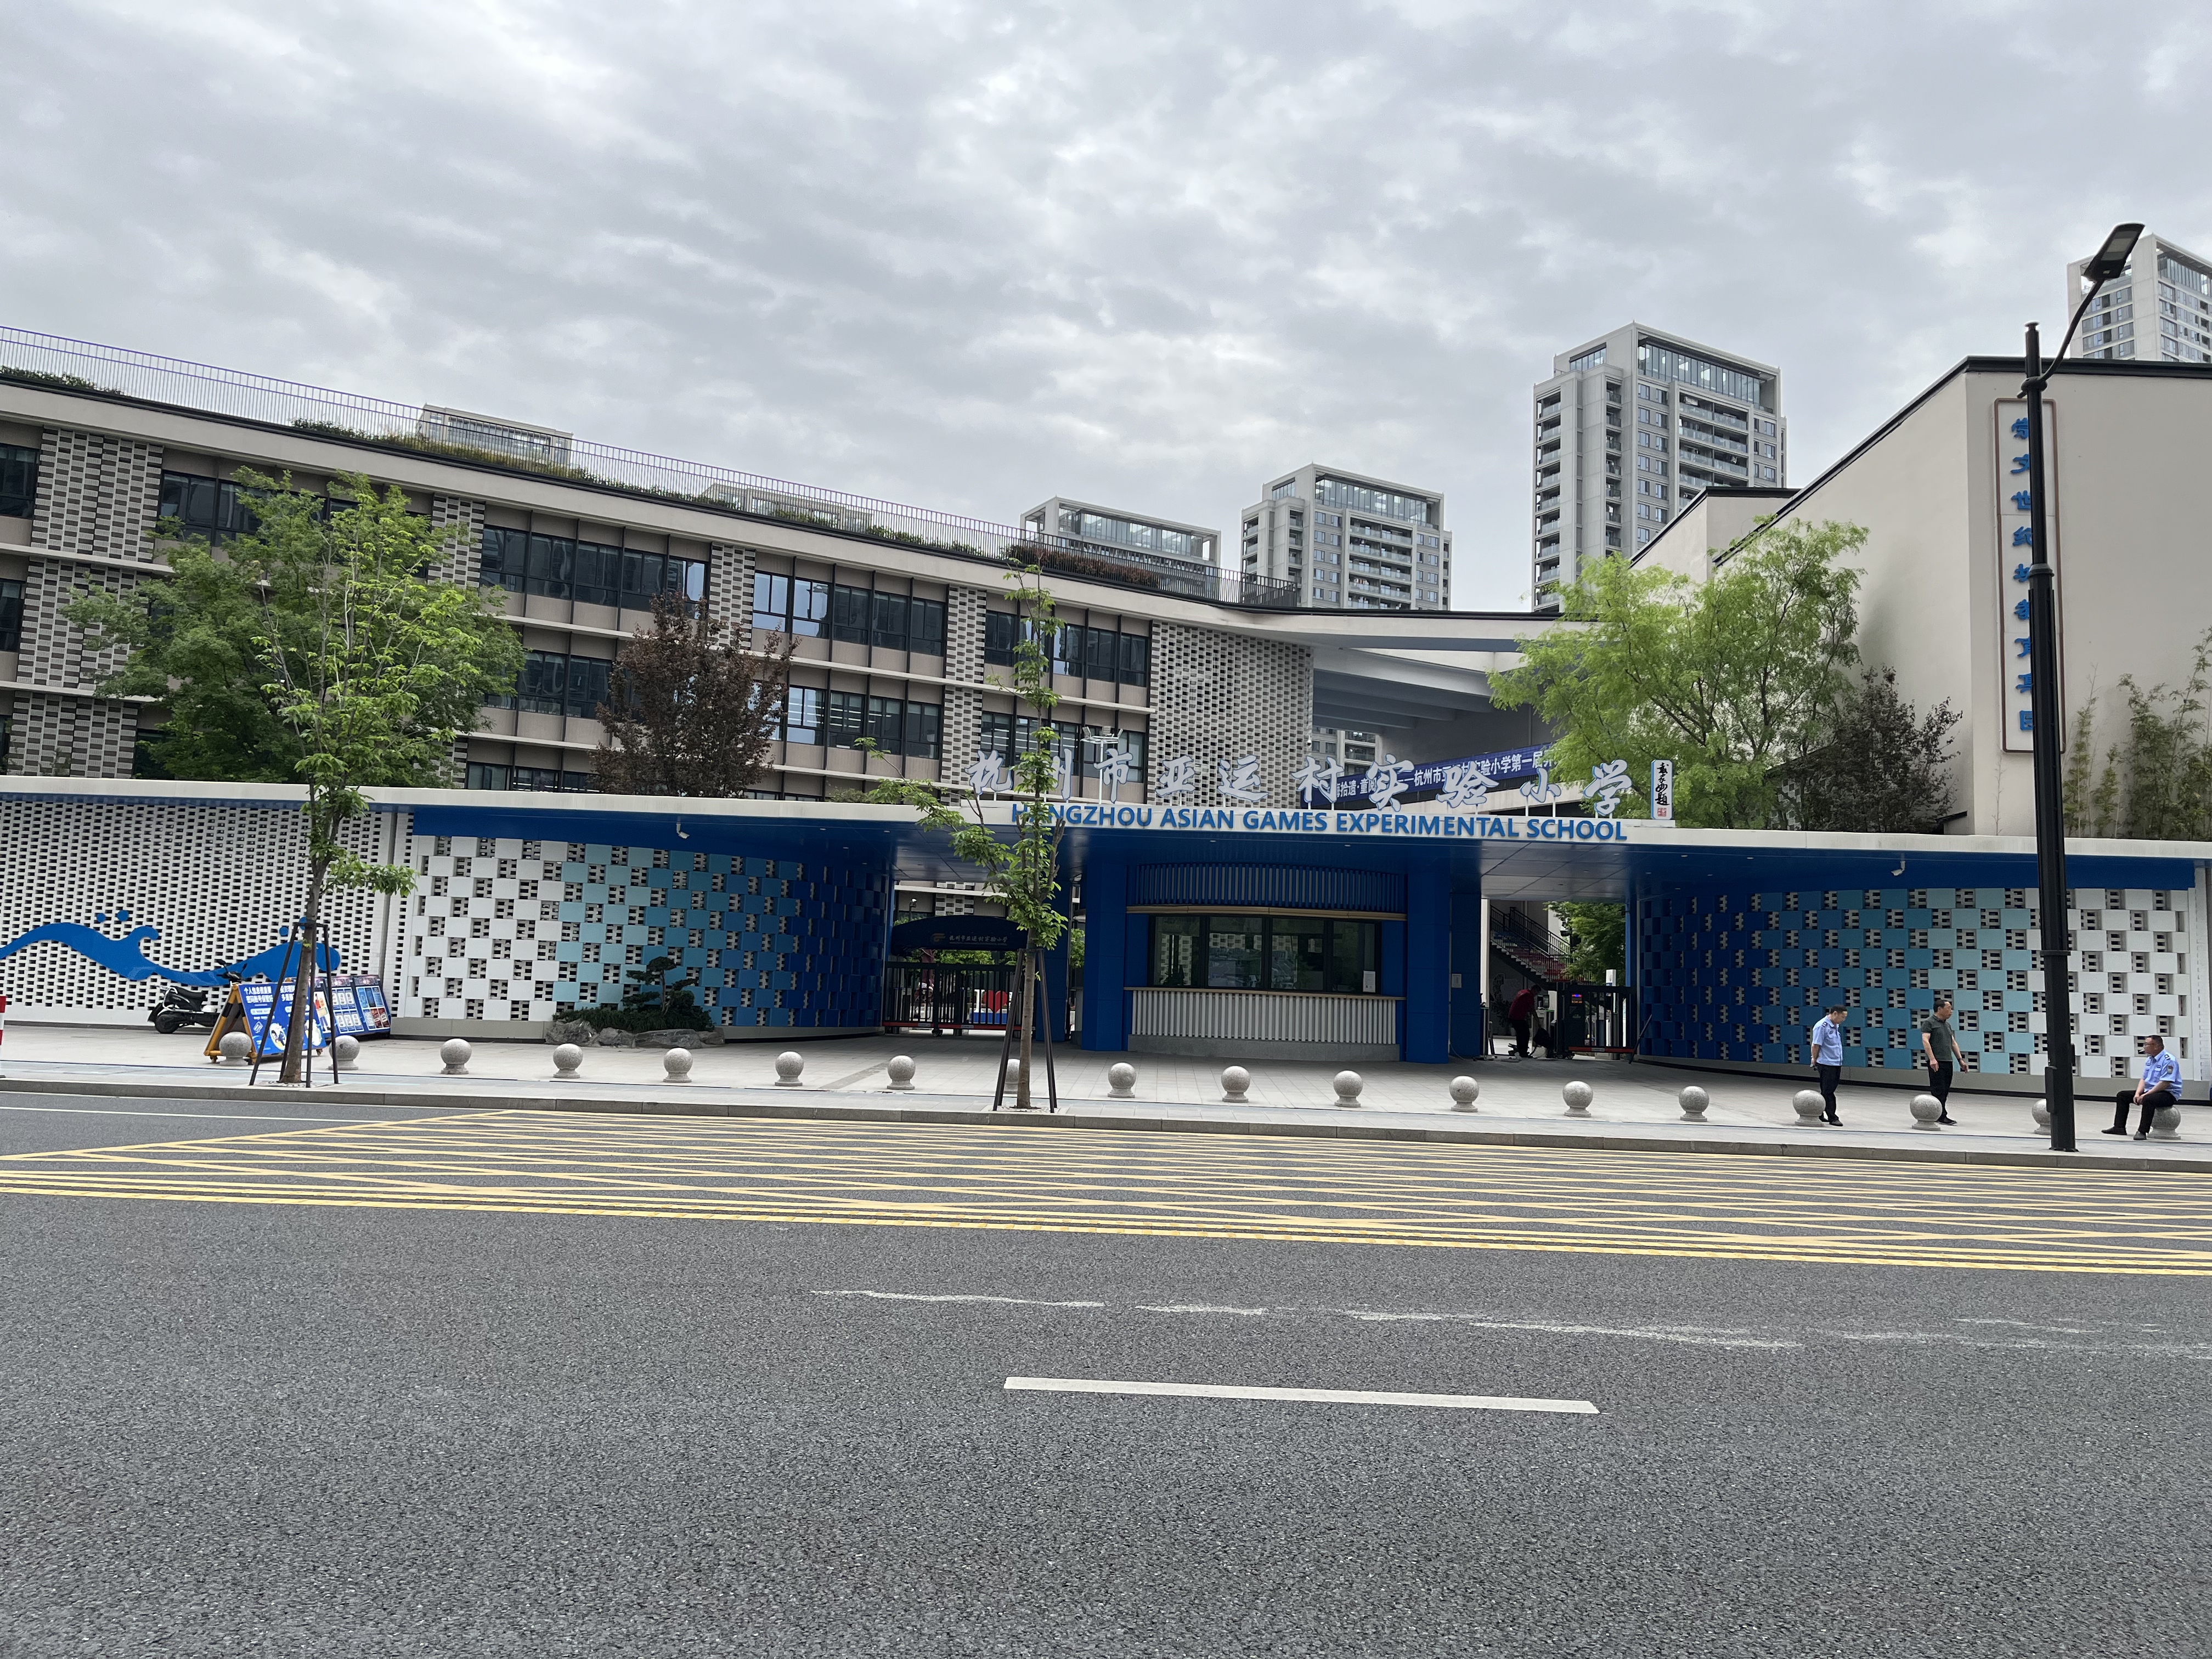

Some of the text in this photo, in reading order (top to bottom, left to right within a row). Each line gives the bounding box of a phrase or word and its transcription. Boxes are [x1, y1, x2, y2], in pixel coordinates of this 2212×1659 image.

[964, 748, 1632, 816] 杭州市亚运村实验小学
[1012, 803, 1627, 840] HNGZHOU ASIAN GAMES EXPERIMENTAL SCHOOL
